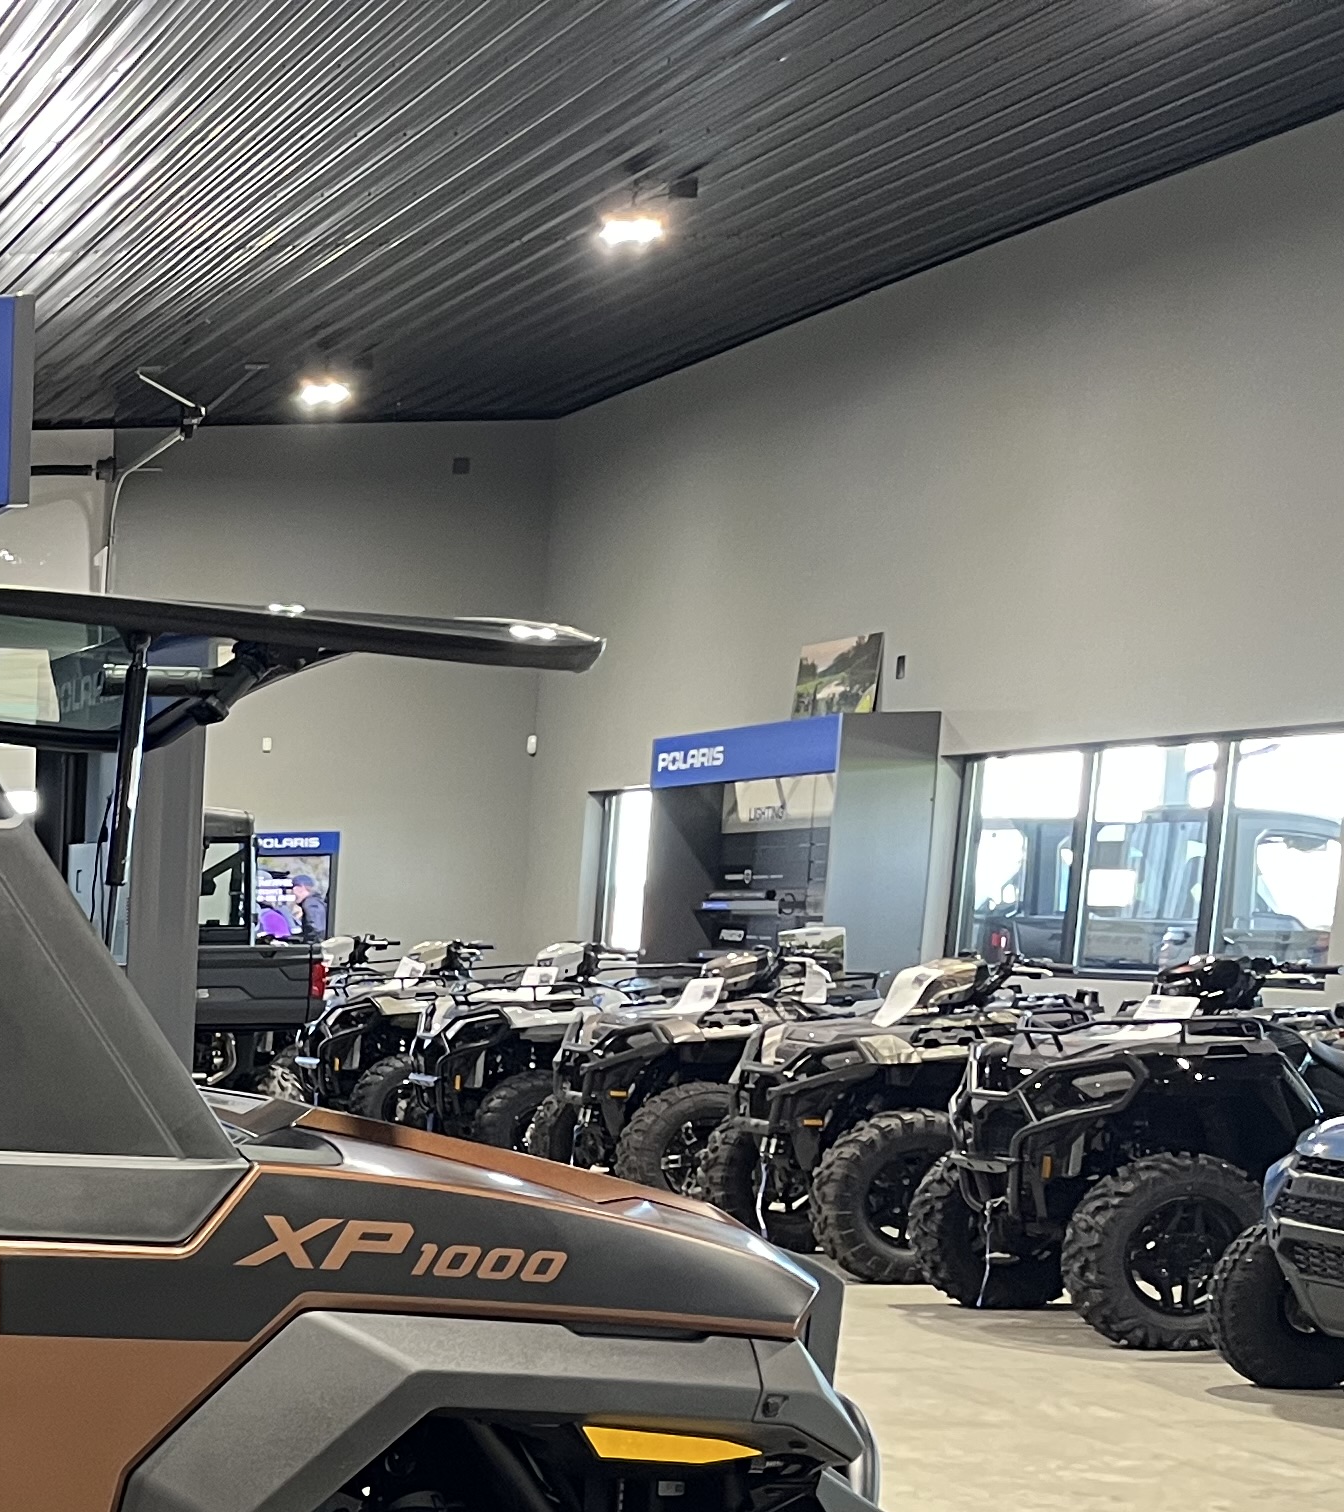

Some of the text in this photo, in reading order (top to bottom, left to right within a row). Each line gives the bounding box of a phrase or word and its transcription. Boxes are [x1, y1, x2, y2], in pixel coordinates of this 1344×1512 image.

[657, 745, 724, 772] POLARIS
[748, 805, 785, 821] LIGHTING
[233, 1214, 567, 1283] XP 1000
